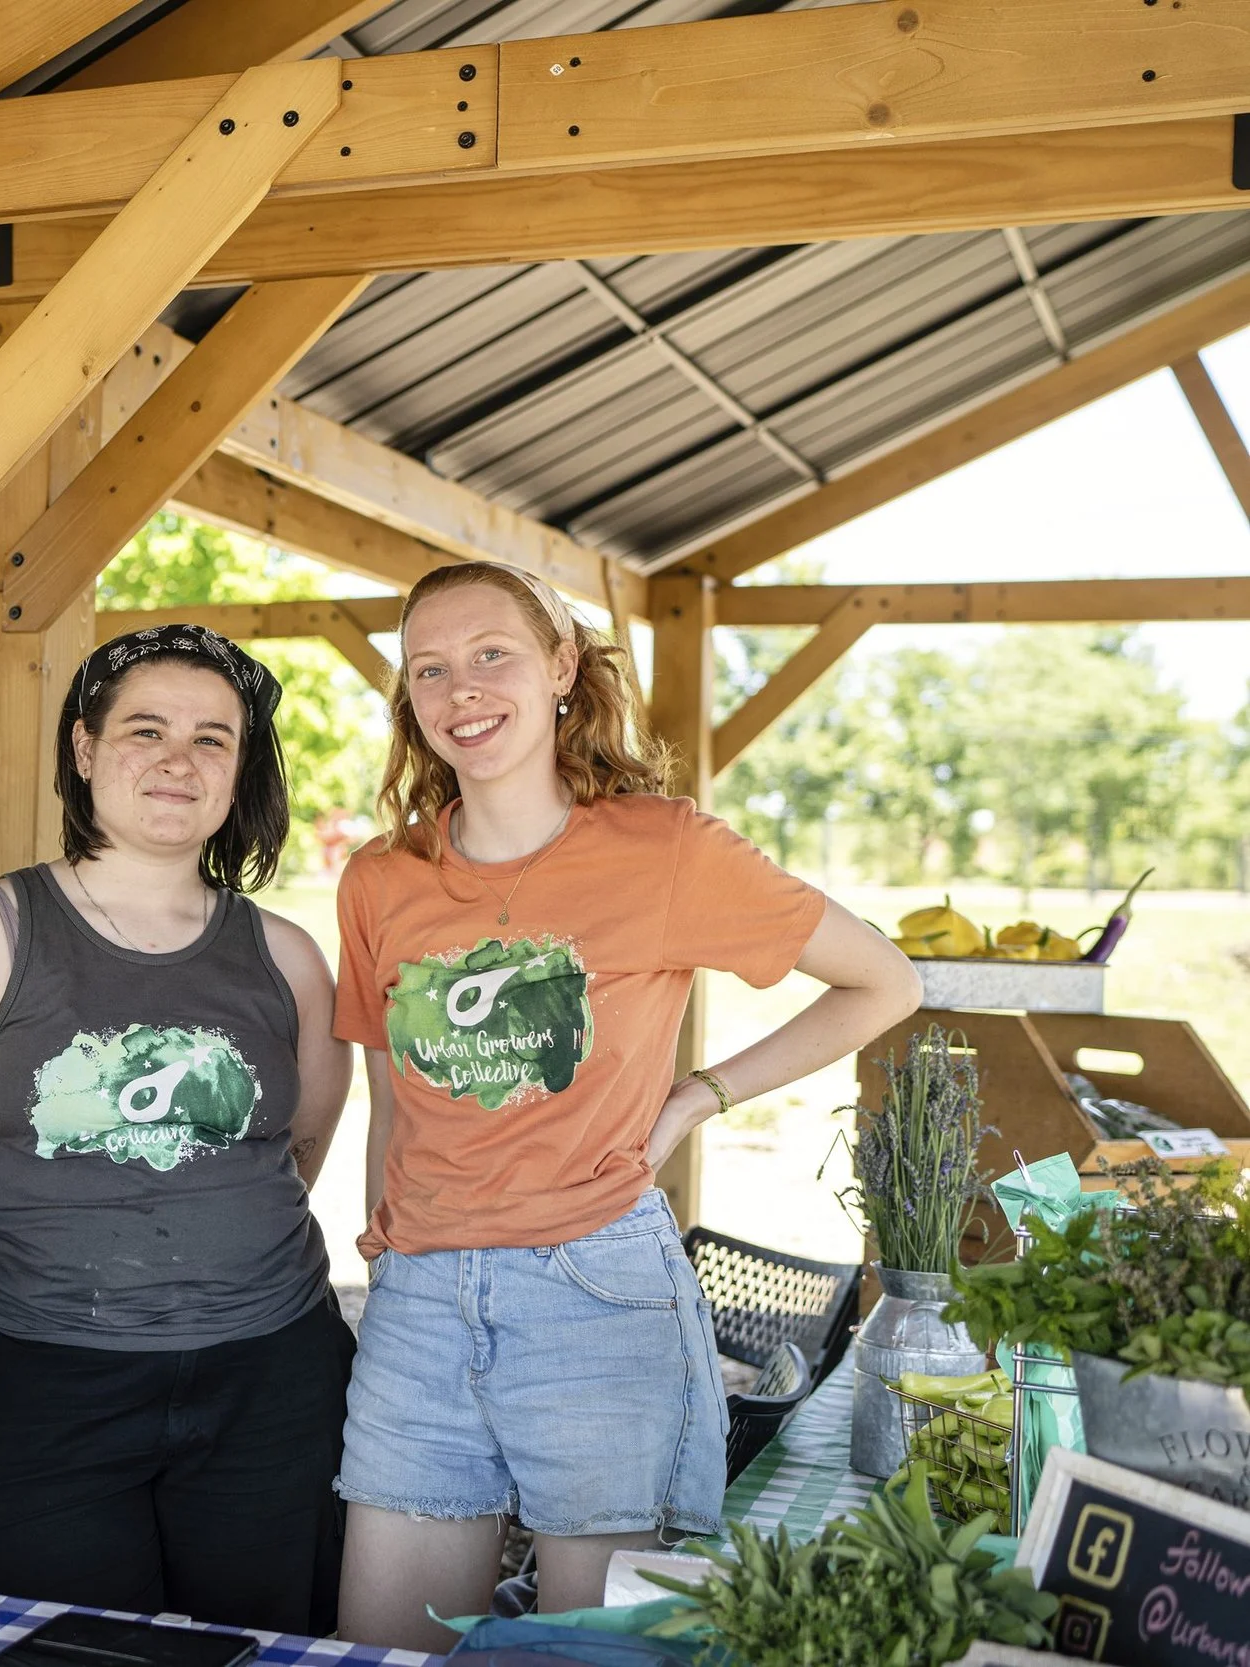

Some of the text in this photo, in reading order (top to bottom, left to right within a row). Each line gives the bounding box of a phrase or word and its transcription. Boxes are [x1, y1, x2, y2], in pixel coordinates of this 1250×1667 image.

[415, 1030, 556, 1064] Urban Growers
[451, 1060, 533, 1090] Collective
[105, 1124, 191, 1153] Collective
